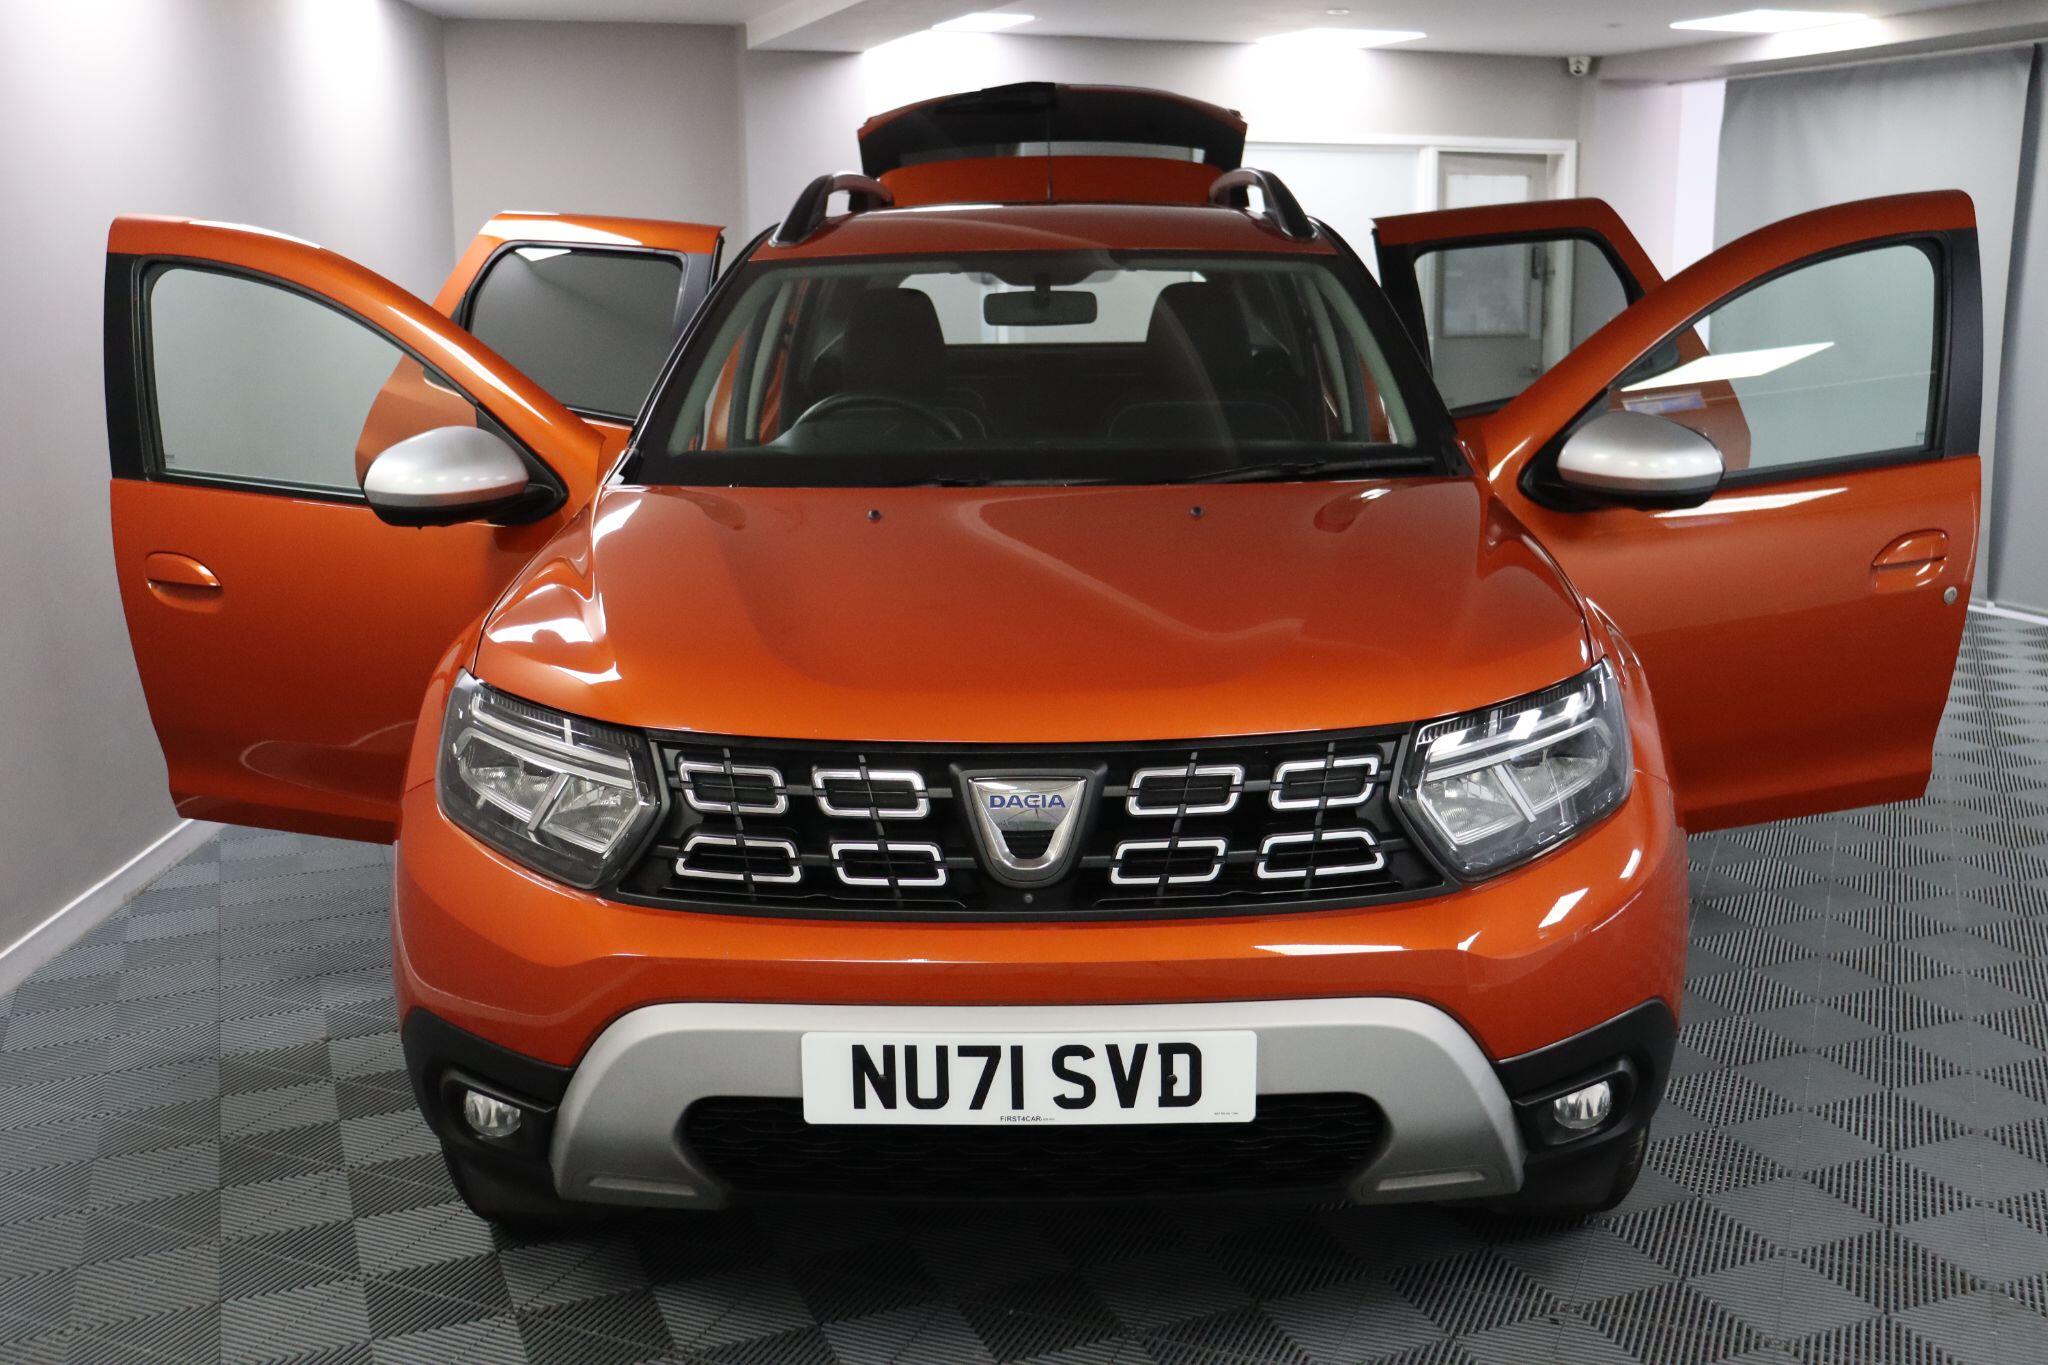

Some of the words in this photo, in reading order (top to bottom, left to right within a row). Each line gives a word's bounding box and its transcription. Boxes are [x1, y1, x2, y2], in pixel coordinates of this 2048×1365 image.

[989, 794, 1066, 809] DACIA
[851, 1044, 1024, 1110] NU71
[1051, 1042, 1203, 1109] SVD
